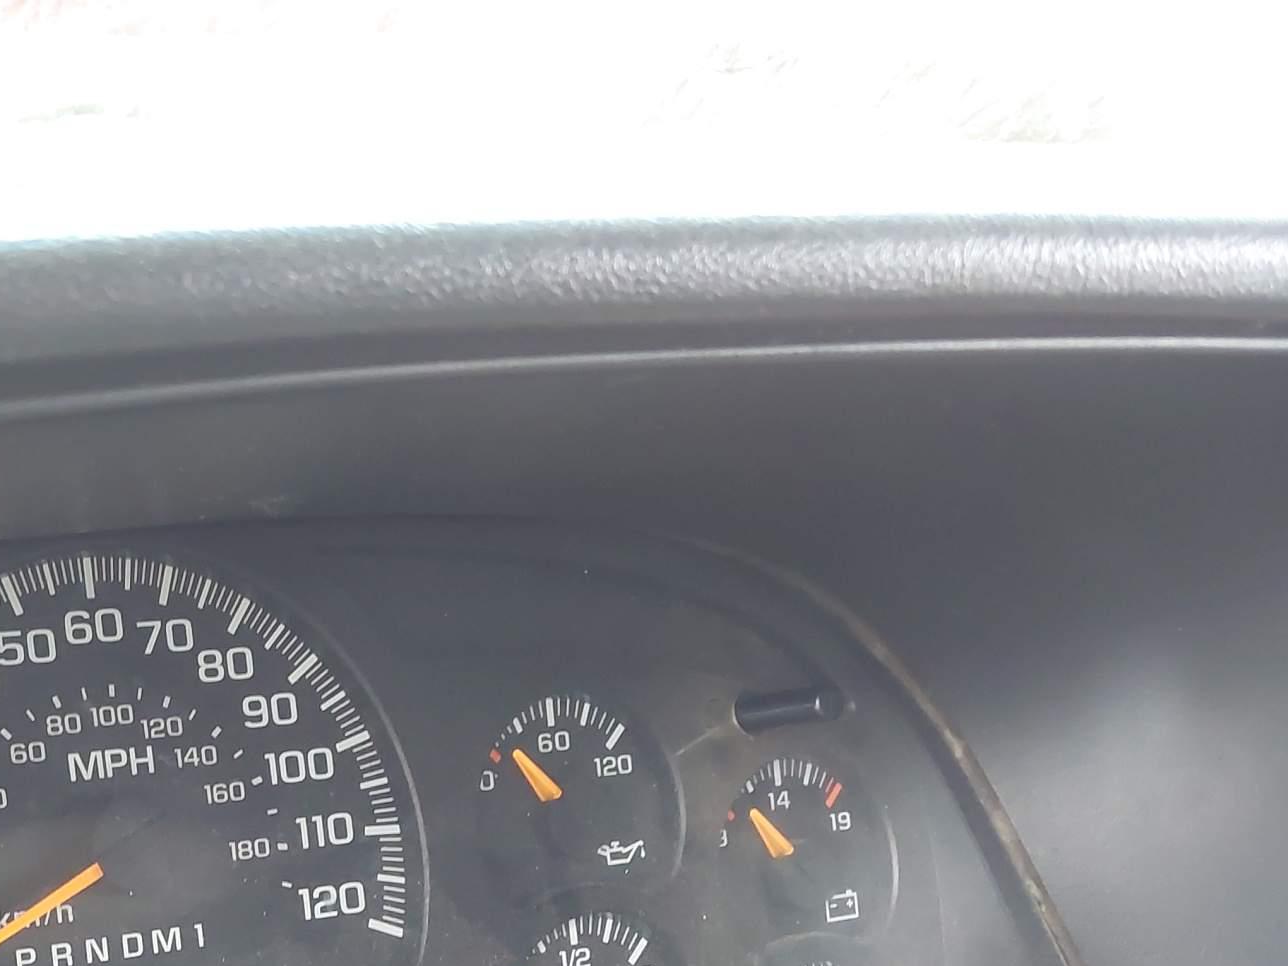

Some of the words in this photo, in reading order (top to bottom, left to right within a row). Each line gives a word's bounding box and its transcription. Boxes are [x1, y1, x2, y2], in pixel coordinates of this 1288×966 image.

[64, 608, 124, 645] 60
[136, 618, 194, 655] 70
[197, 647, 254, 683] 80
[90, 704, 134, 727] 100
[242, 692, 298, 728] 90
[46, 713, 82, 736] 80
[140, 716, 183, 739] 120
[10, 741, 46, 764] 60
[537, 731, 570, 753] 60
[67, 745, 155, 782] MPH
[174, 745, 217, 769] 140
[264, 747, 336, 786] 100
[593, 754, 633, 777] 120
[479, 770, 495, 791] 0
[203, 781, 245, 804] 160
[767, 790, 791, 811] 14
[295, 812, 354, 850] 110
[829, 811, 851, 831] 19
[228, 838, 270, 861] 180
[298, 881, 366, 921] 120
